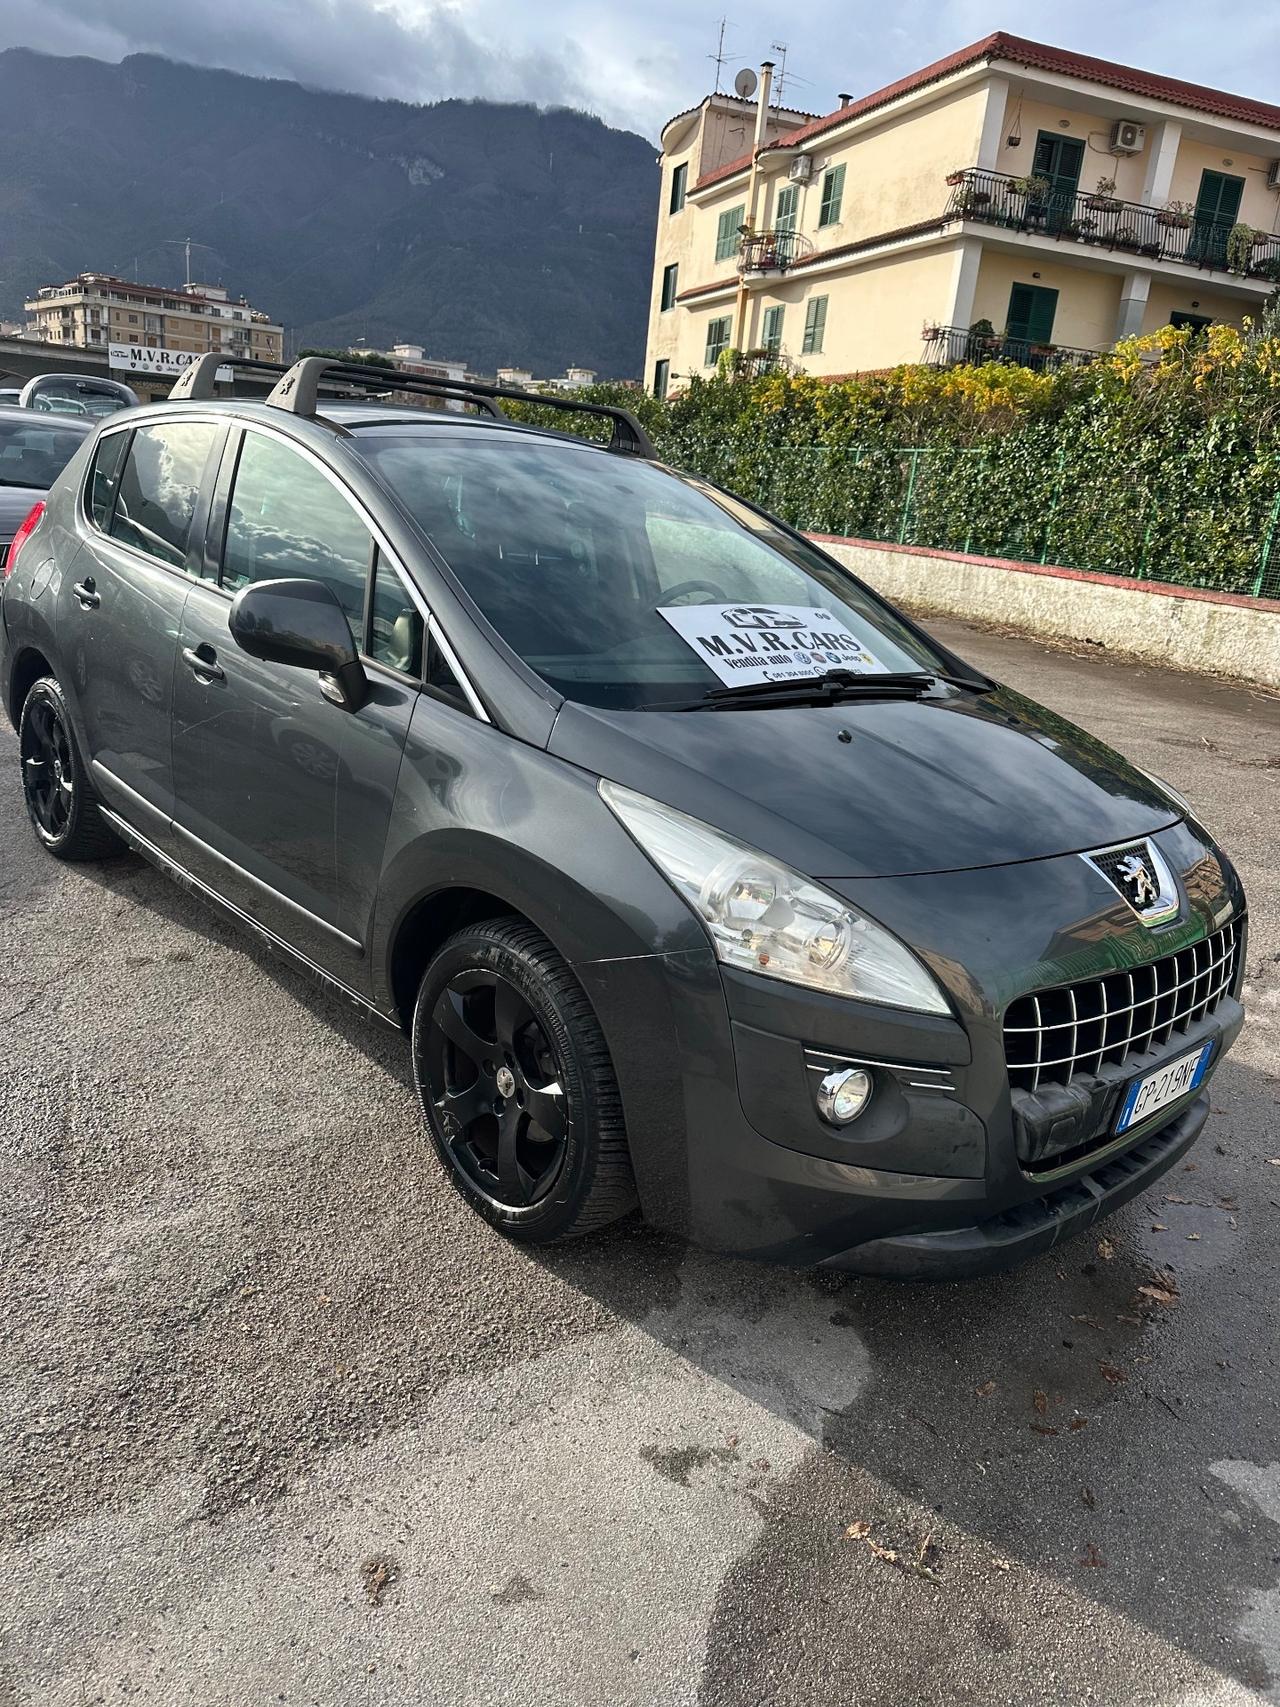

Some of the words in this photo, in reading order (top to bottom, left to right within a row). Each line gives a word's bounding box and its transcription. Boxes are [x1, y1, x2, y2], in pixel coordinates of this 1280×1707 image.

[130, 348, 198, 366] M.V.R.CA
[696, 631, 861, 658] M.V.R.CARS
[723, 655, 769, 670] Vendita
[767, 653, 793, 665] auto
